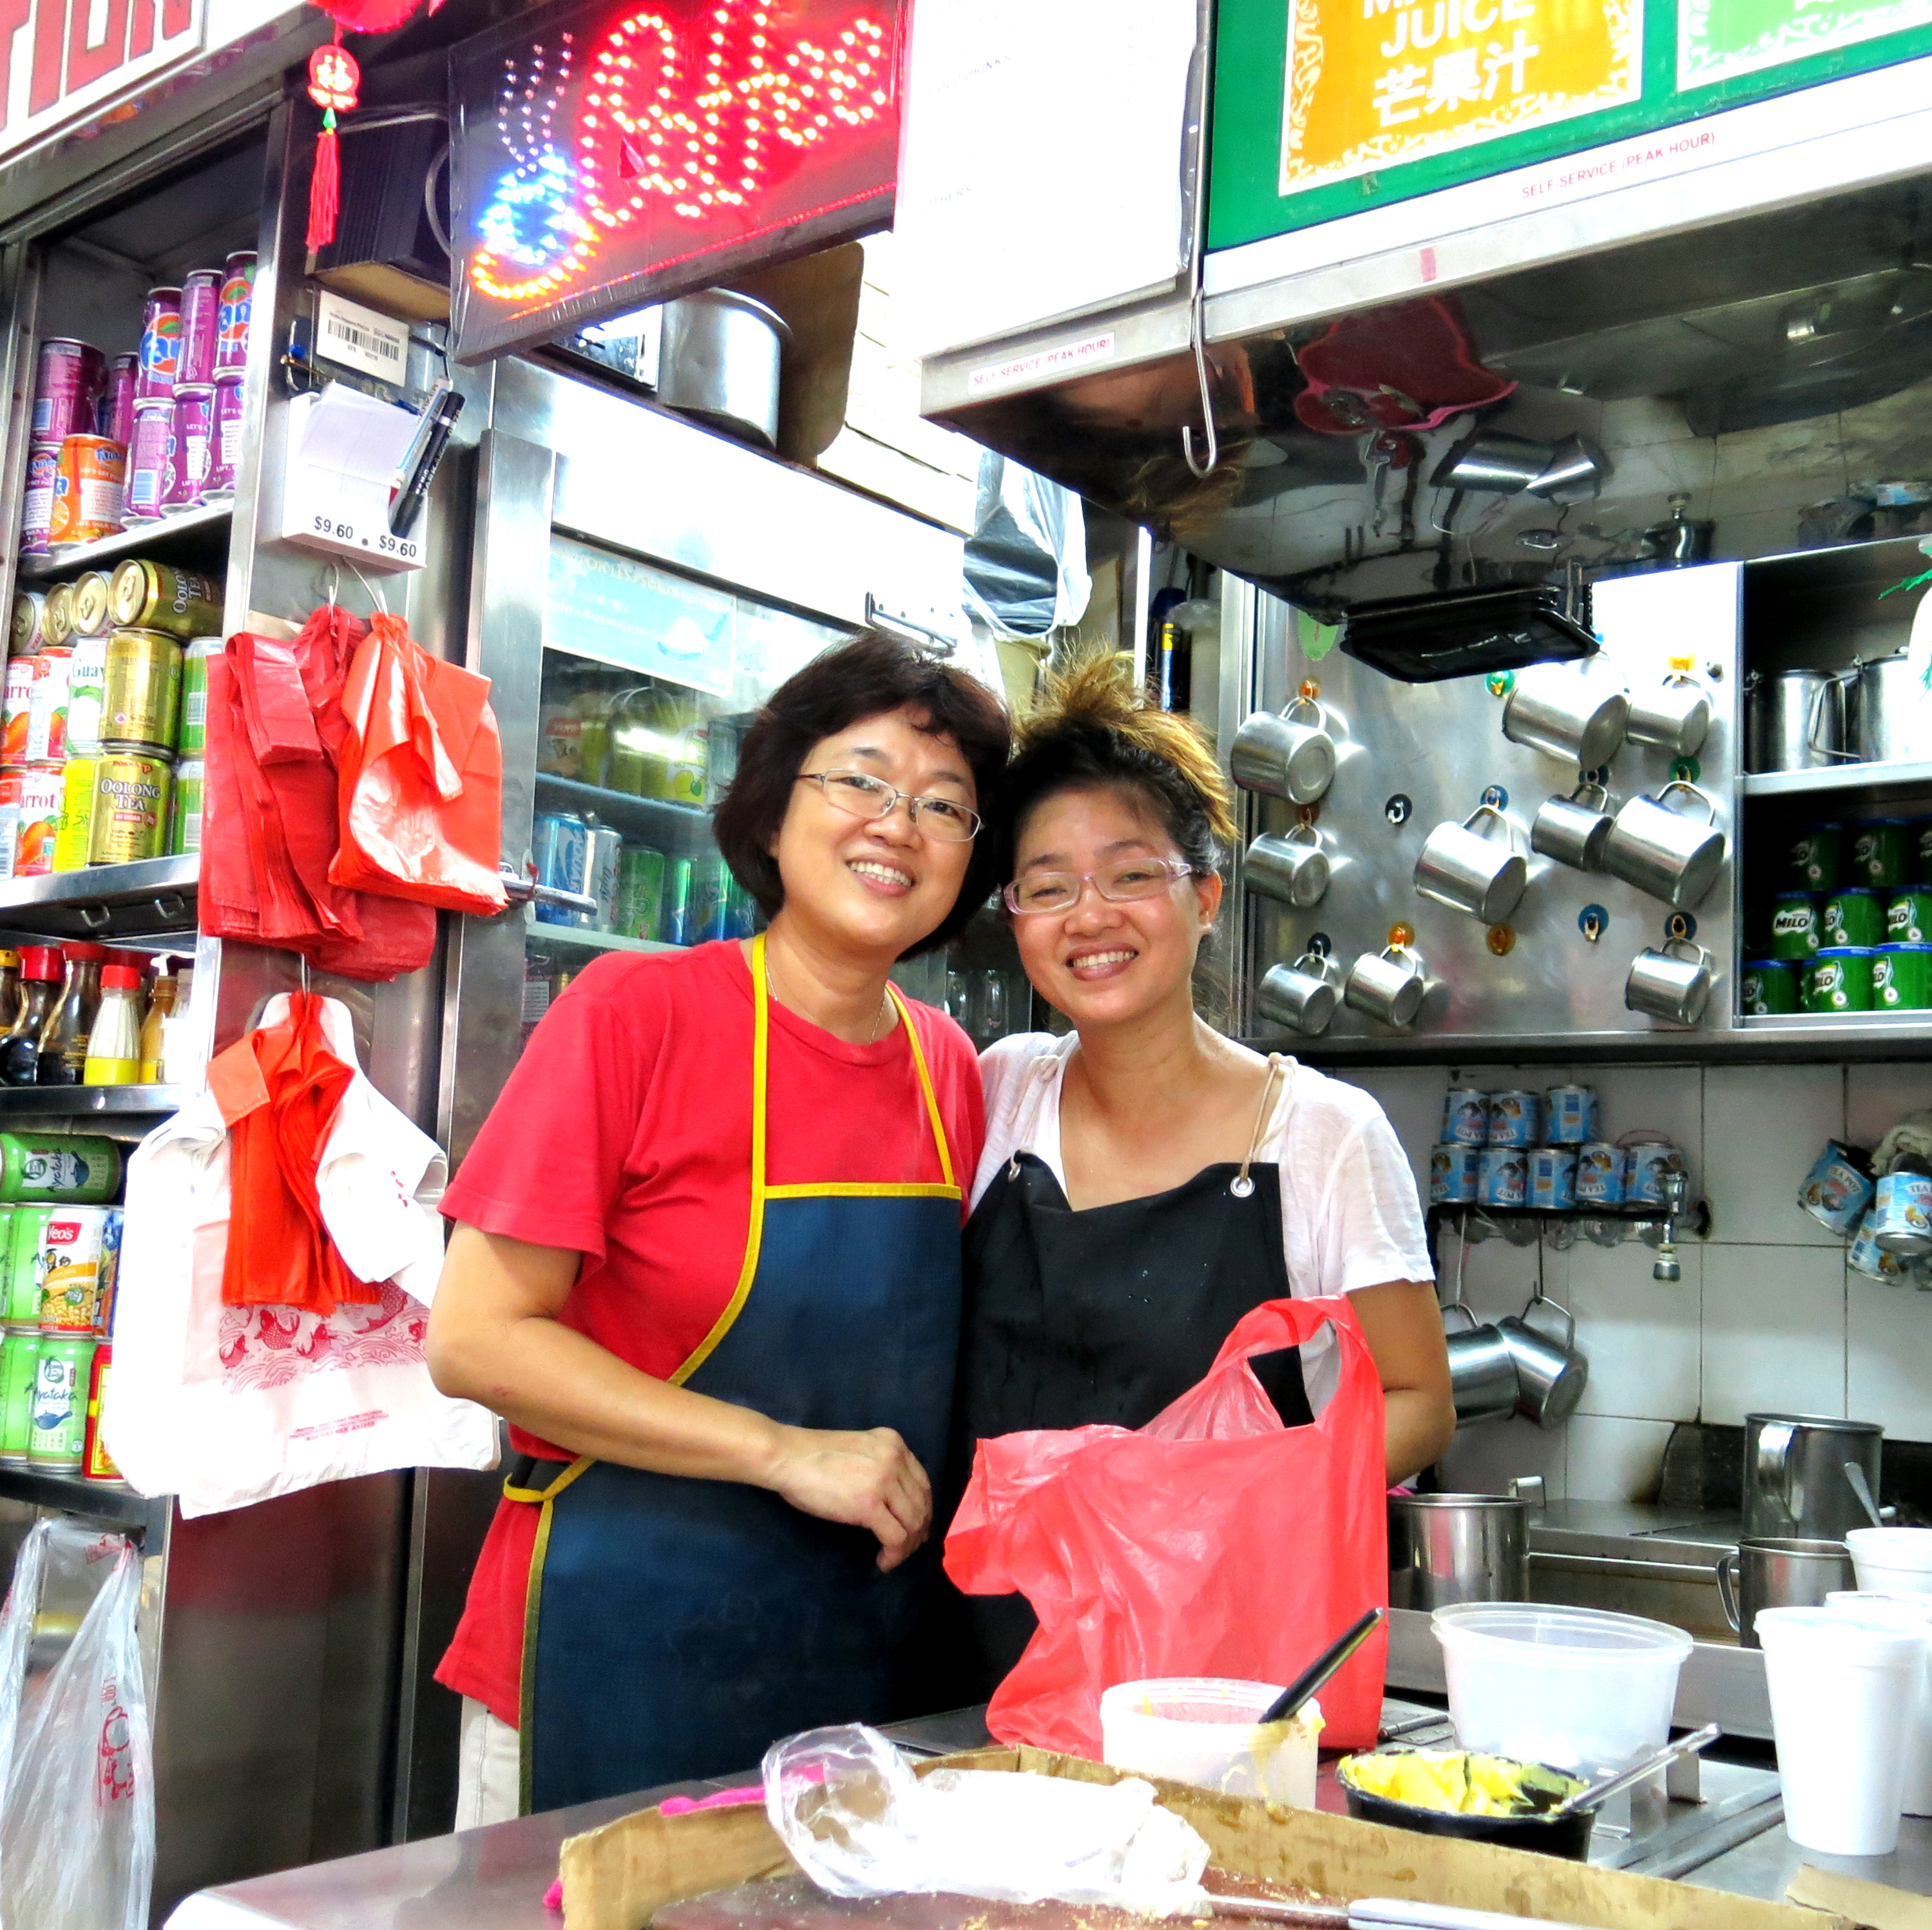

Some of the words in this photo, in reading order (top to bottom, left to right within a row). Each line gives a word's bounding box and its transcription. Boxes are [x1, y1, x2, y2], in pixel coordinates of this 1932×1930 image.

[1381, 0, 1536, 57] JUICE
[1373, 30, 1540, 128] 芒果汁
[1622, 147, 1664, 171] (PEAK
[1669, 131, 1716, 155] HOUR)
[1044, 349, 1074, 367] (PEAK
[1077, 338, 1110, 355] HOUR)
[314, 515, 354, 539] $9.60
[379, 535, 417, 558] $9.60
[72, 658, 104, 678] Guav
[101, 778, 160, 799] OOLONG
[19, 792, 57, 808] arrot
[115, 794, 146, 812] TEA
[1775, 917, 1808, 928] MILO
[48, 1225, 73, 1241] Yeo's
